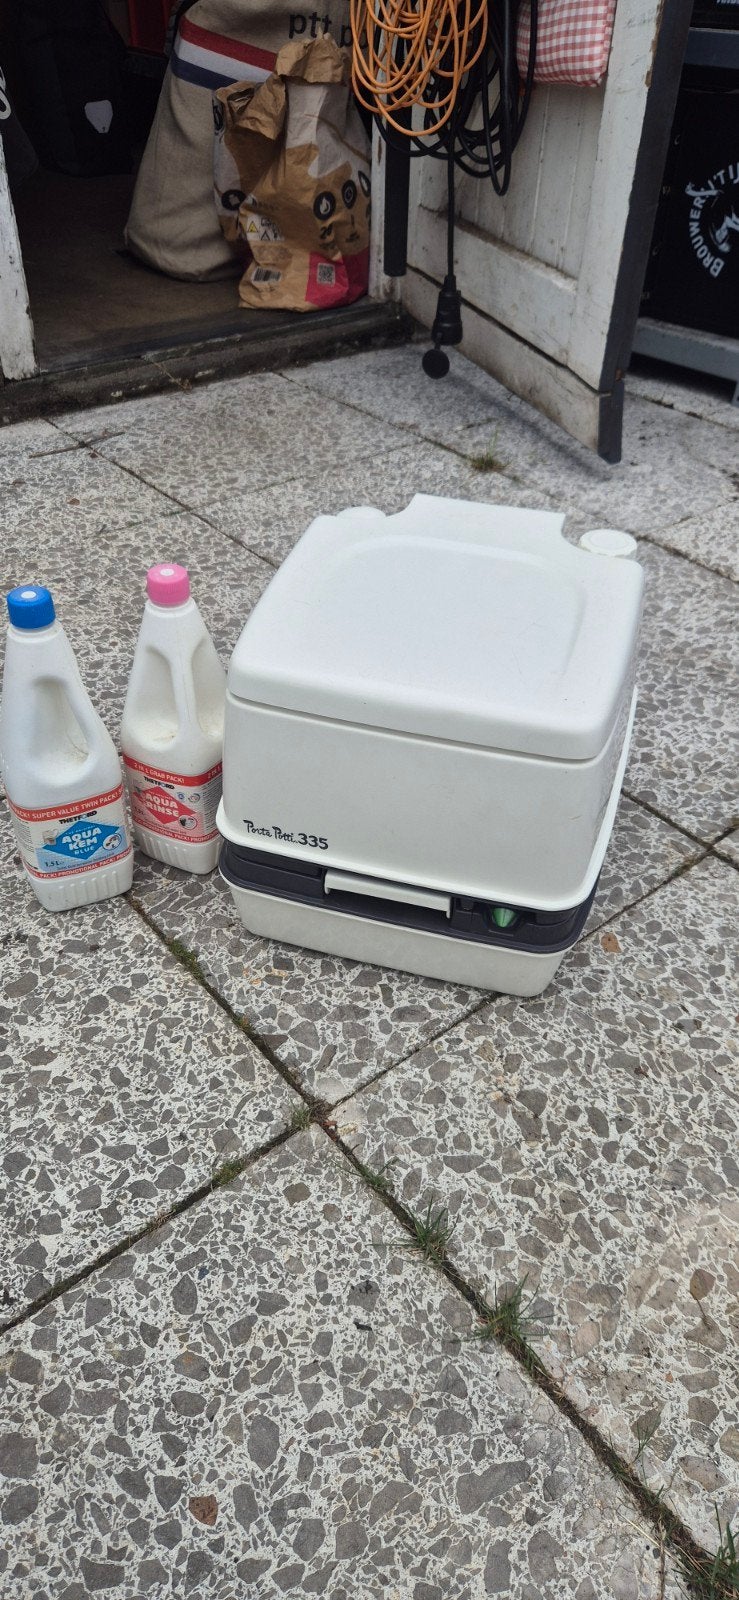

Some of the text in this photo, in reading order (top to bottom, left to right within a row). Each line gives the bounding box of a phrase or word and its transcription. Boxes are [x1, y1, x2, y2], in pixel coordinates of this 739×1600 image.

[32, 811, 57, 820] SUPER
[57, 806, 80, 816] VALUE
[81, 800, 99, 810] TWIN
[99, 793, 117, 804] PACK!
[144, 792, 179, 809] AQUA
[144, 800, 180, 818] RINSE
[61, 827, 103, 844] AQUA
[68, 836, 98, 851] KEM
[298, 832, 329, 850] 335
[74, 845, 95, 855] BLUE
[58, 863, 99, 876] PROMOTIONAL
